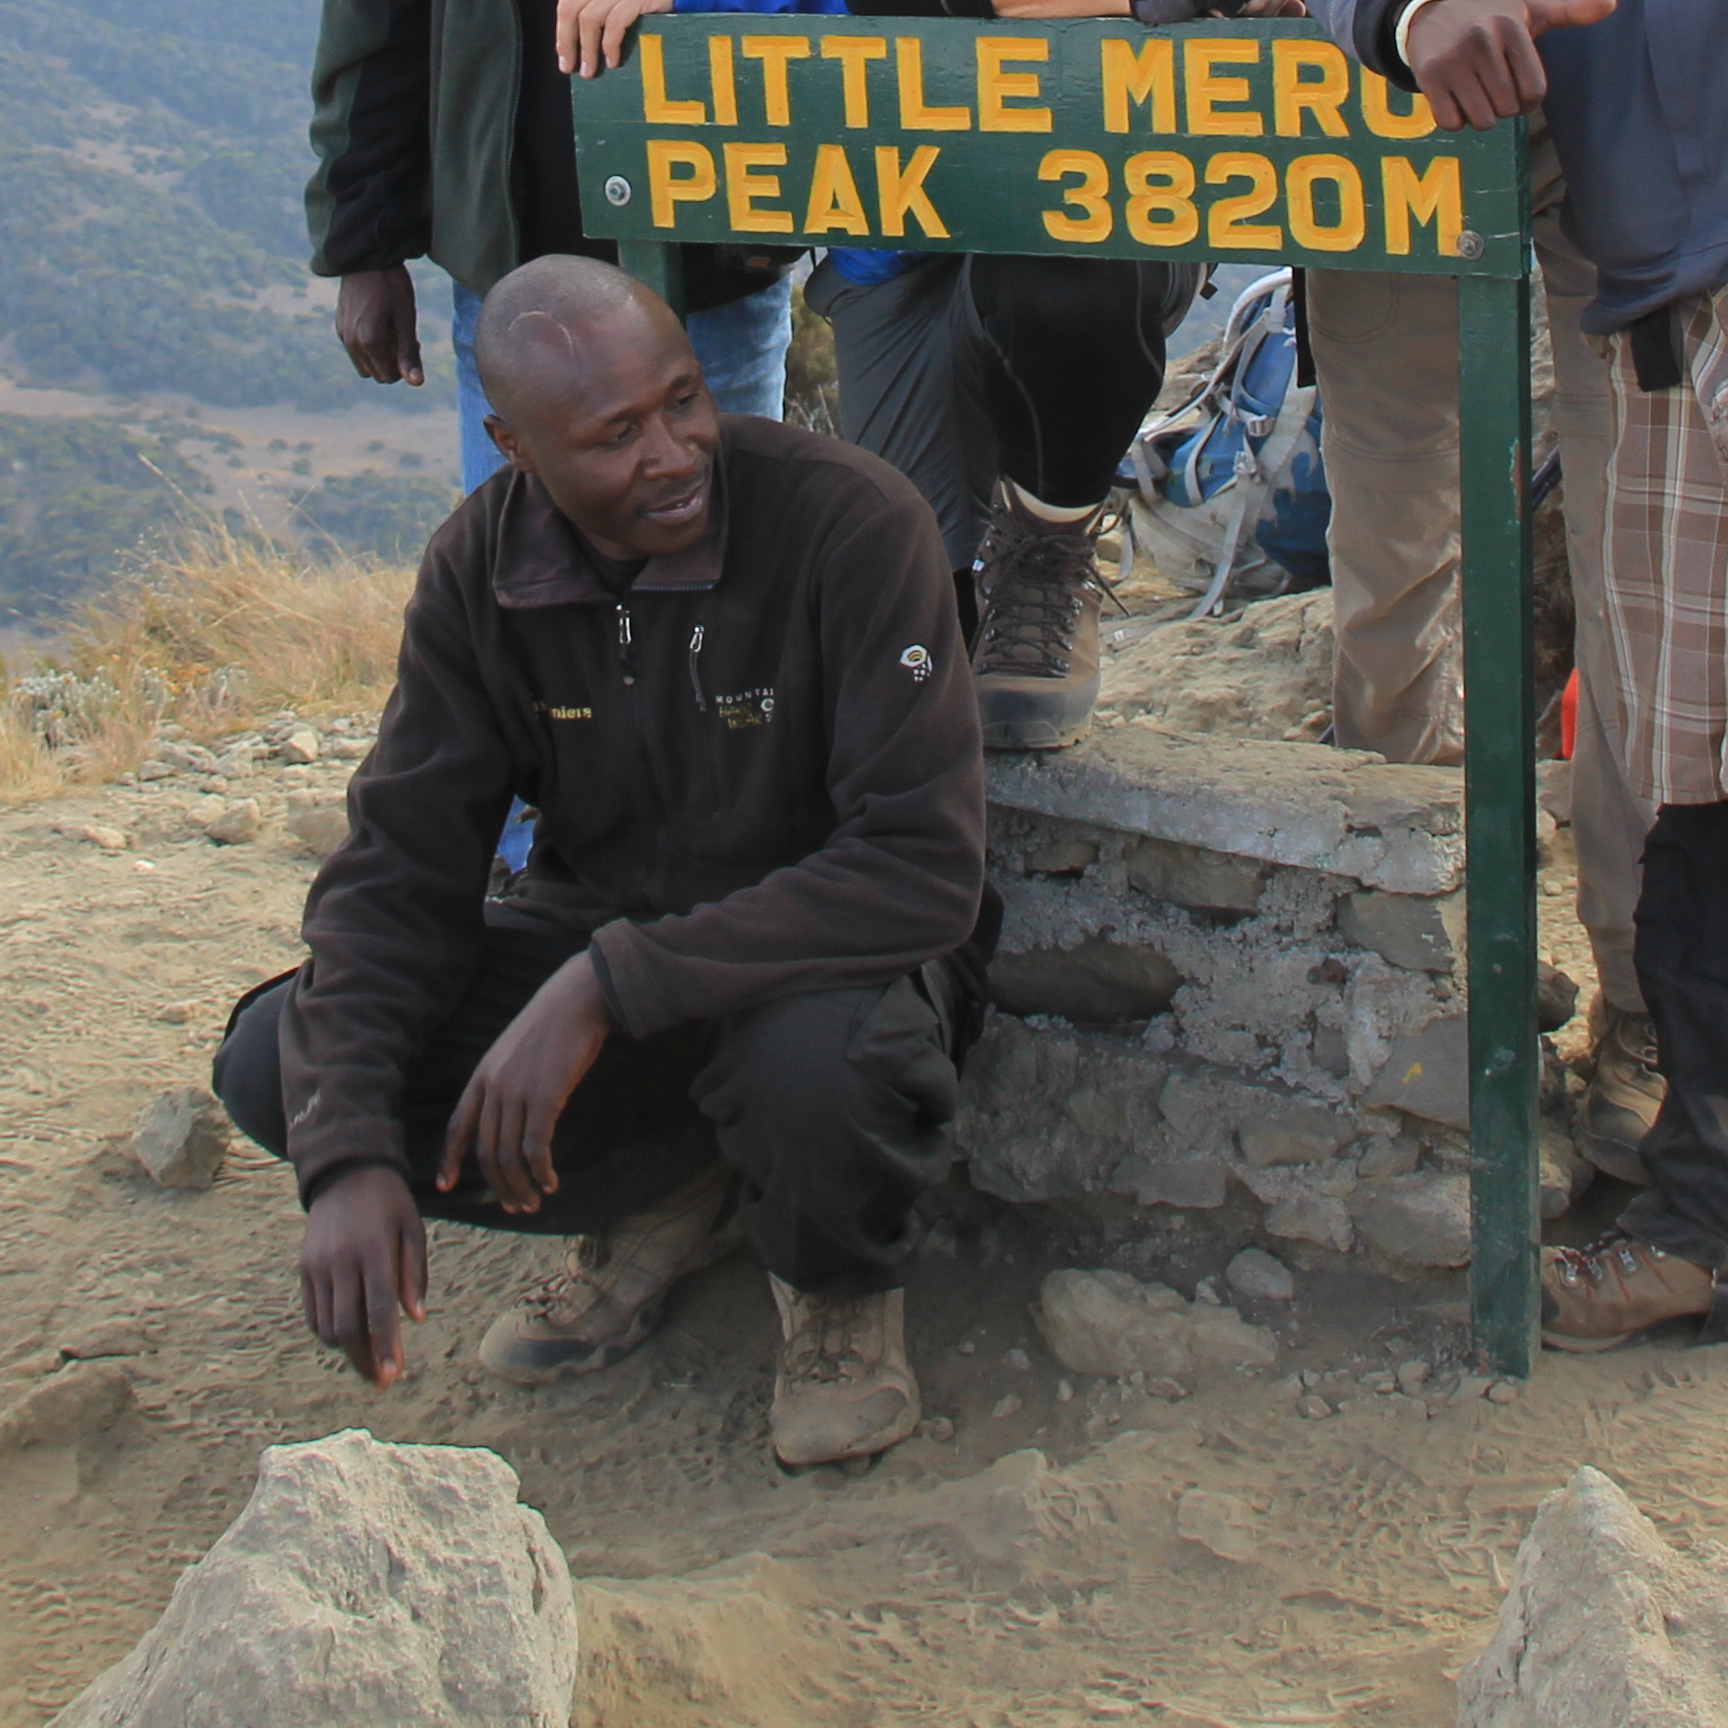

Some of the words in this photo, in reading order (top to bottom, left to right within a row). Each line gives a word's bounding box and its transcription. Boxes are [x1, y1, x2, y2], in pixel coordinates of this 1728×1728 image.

[638, 34, 1053, 133] LITTLE
[646, 140, 951, 239] PEAK
[1038, 149, 1463, 257] 3820M
[715, 687, 774, 704] MOUNTAI
